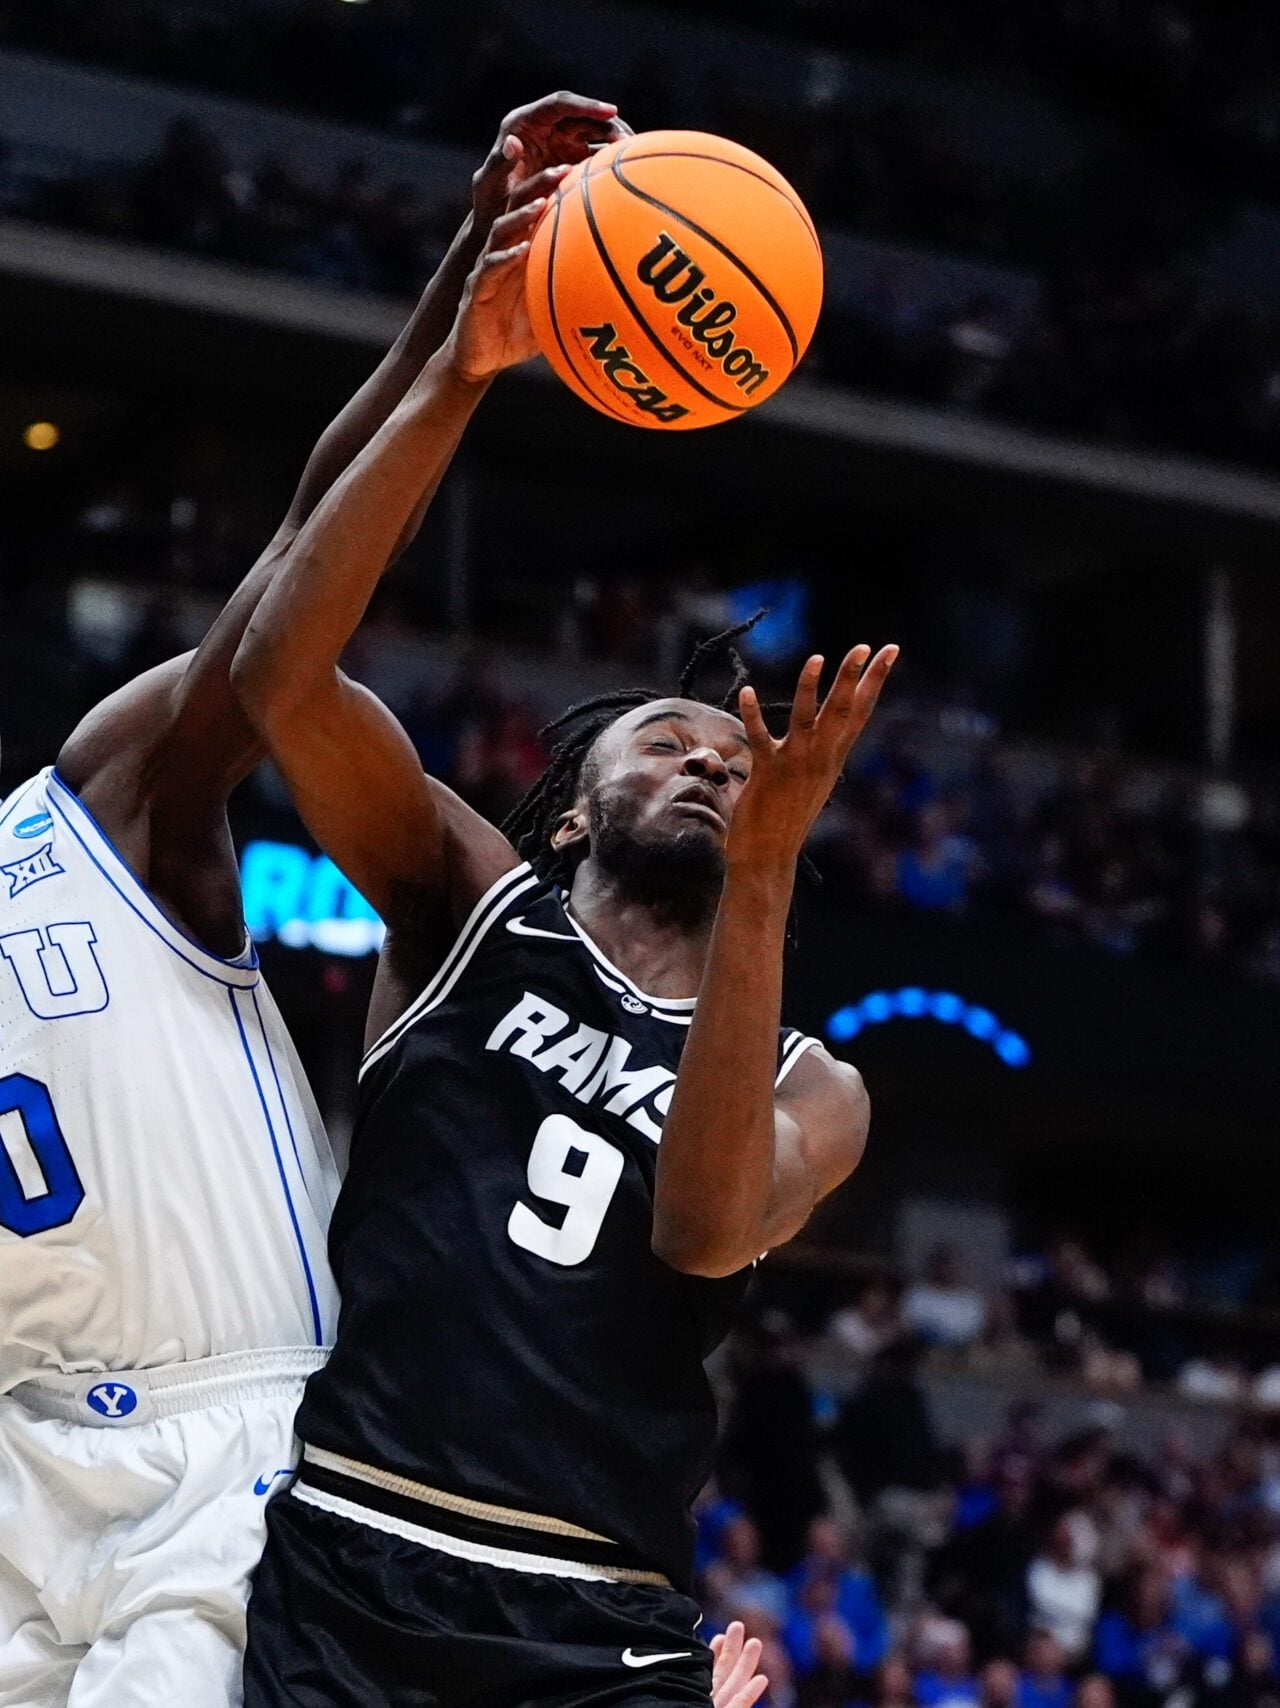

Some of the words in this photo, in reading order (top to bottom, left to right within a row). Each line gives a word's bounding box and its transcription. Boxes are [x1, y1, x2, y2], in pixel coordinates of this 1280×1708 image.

[636, 230, 770, 397] Wilson
[670, 325, 693, 350] EVO
[692, 350, 713, 370] NXT
[578, 322, 691, 423] NCAA
[507, 1113, 625, 1267] 9
[92, 1386, 128, 1416] Y
